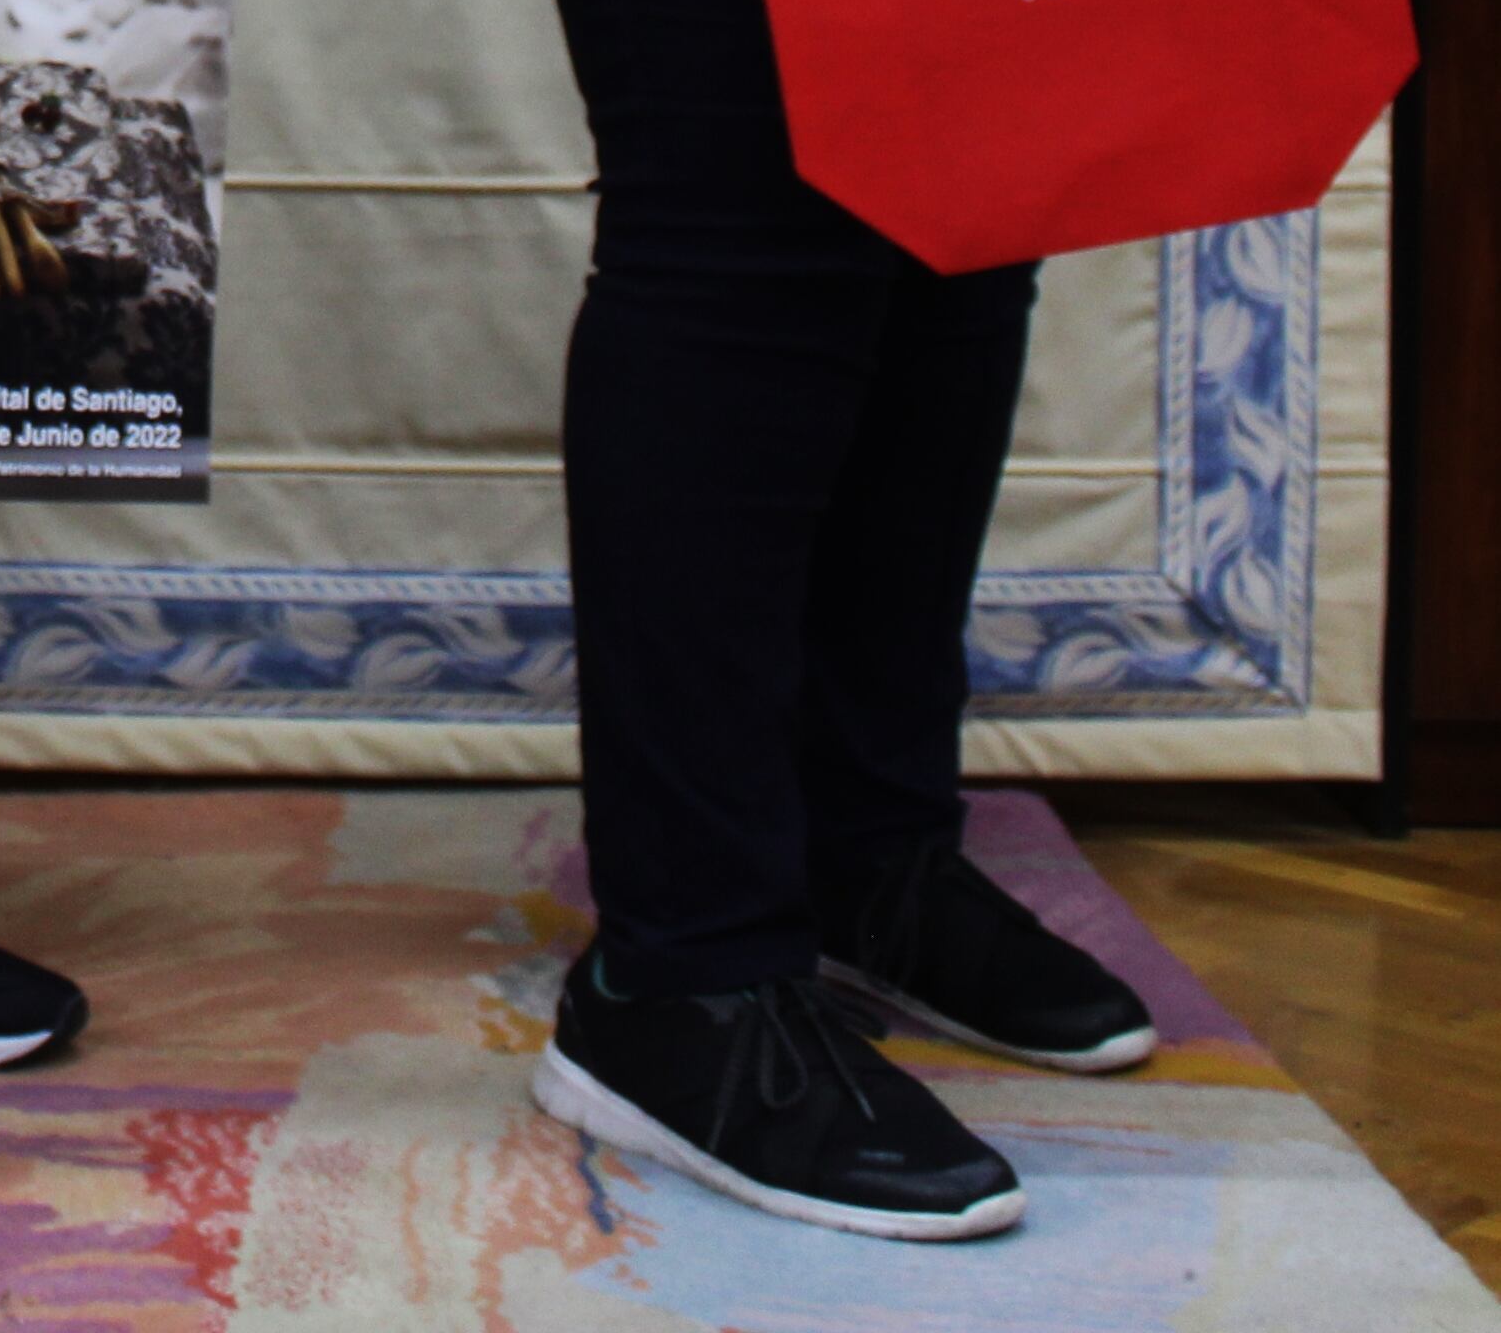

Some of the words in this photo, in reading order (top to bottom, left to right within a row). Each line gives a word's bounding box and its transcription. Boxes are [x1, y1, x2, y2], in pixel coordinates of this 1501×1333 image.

[35, 388, 66, 411] de
[70, 386, 183, 418] Santiago,
[15, 420, 84, 447] Junio
[89, 422, 120, 448] de
[124, 424, 182, 449] 2022
